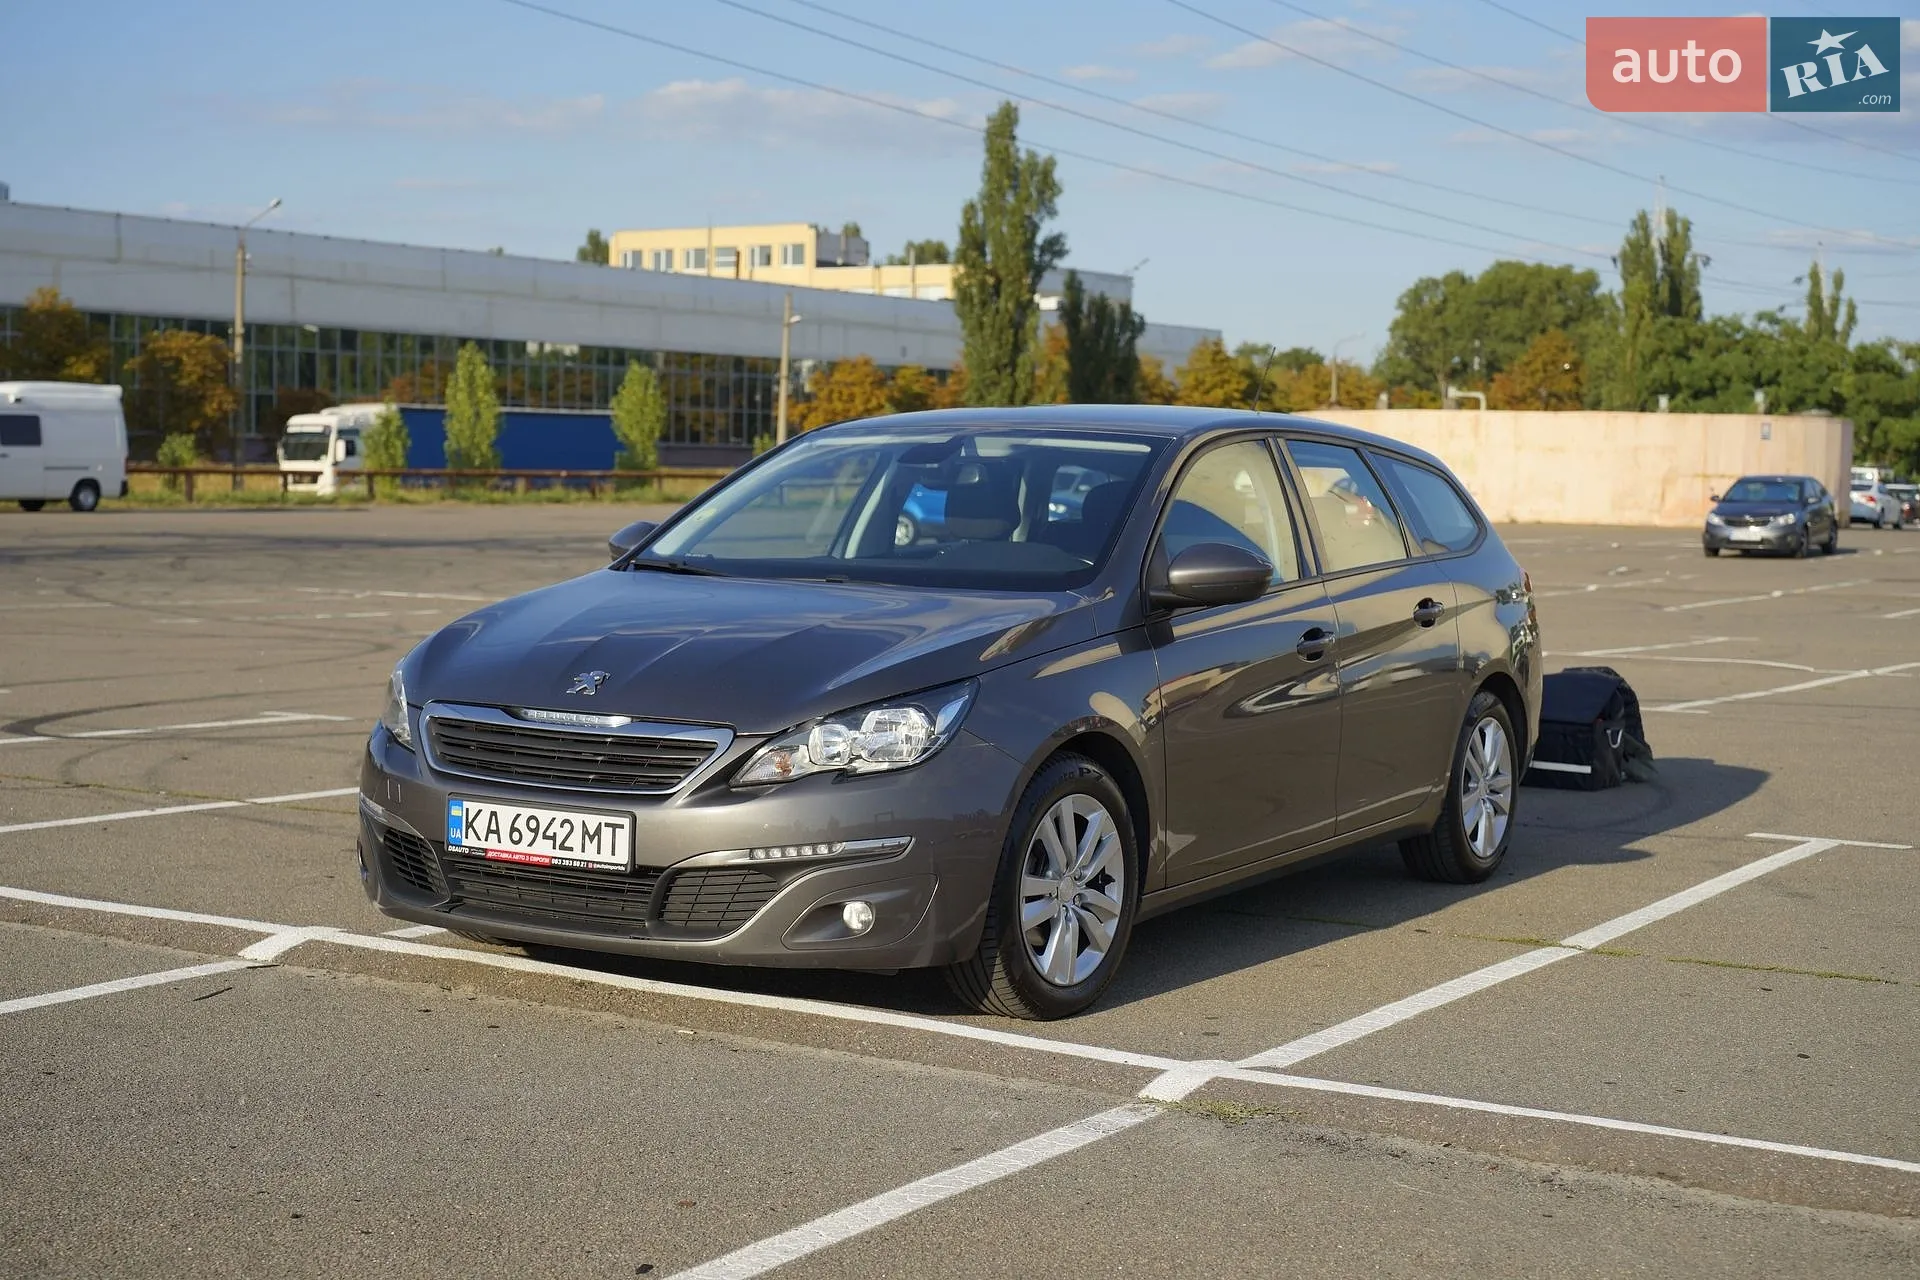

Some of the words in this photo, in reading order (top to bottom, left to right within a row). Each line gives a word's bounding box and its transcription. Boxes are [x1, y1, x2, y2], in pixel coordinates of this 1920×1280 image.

[450, 828, 462, 839] UA
[465, 807, 501, 844] KA
[509, 813, 574, 852] 6942
[581, 819, 625, 856] MT
